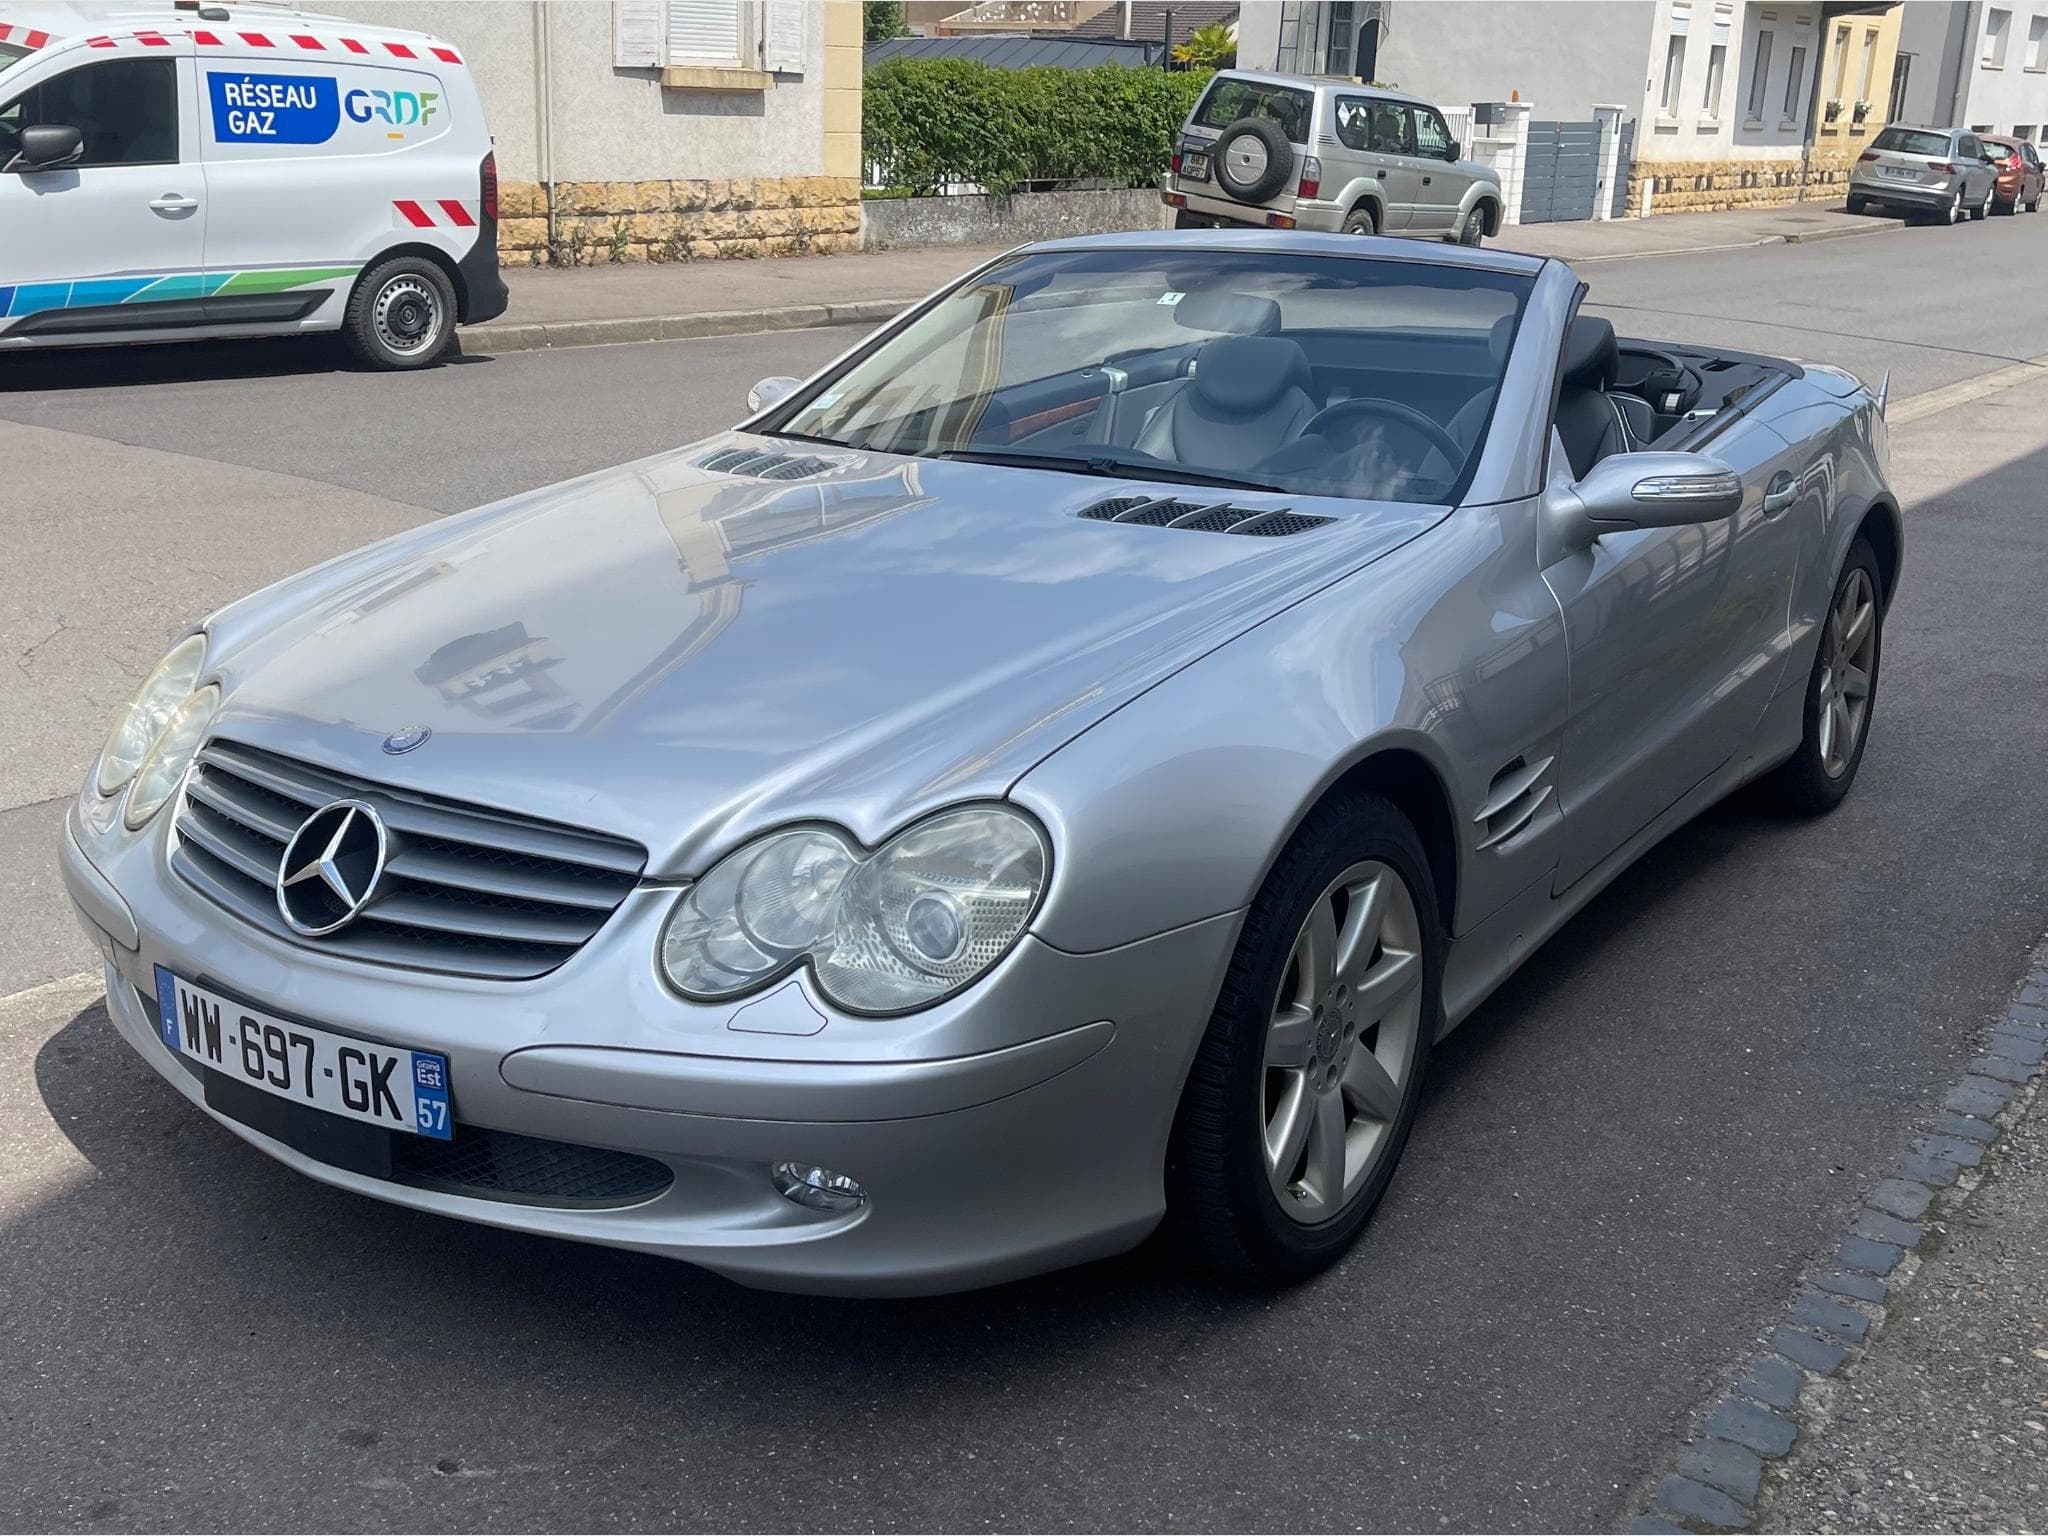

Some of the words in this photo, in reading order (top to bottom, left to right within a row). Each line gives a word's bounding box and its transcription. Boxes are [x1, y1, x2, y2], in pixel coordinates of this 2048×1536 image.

[225, 77, 317, 109] RÉSEAU
[345, 89, 438, 126] GRDF
[228, 111, 277, 135] GAZ
[166, 1018, 173, 1035] F
[416, 1060, 440, 1072] Grand
[417, 1068, 442, 1087] Est
[418, 1097, 446, 1130] 57
